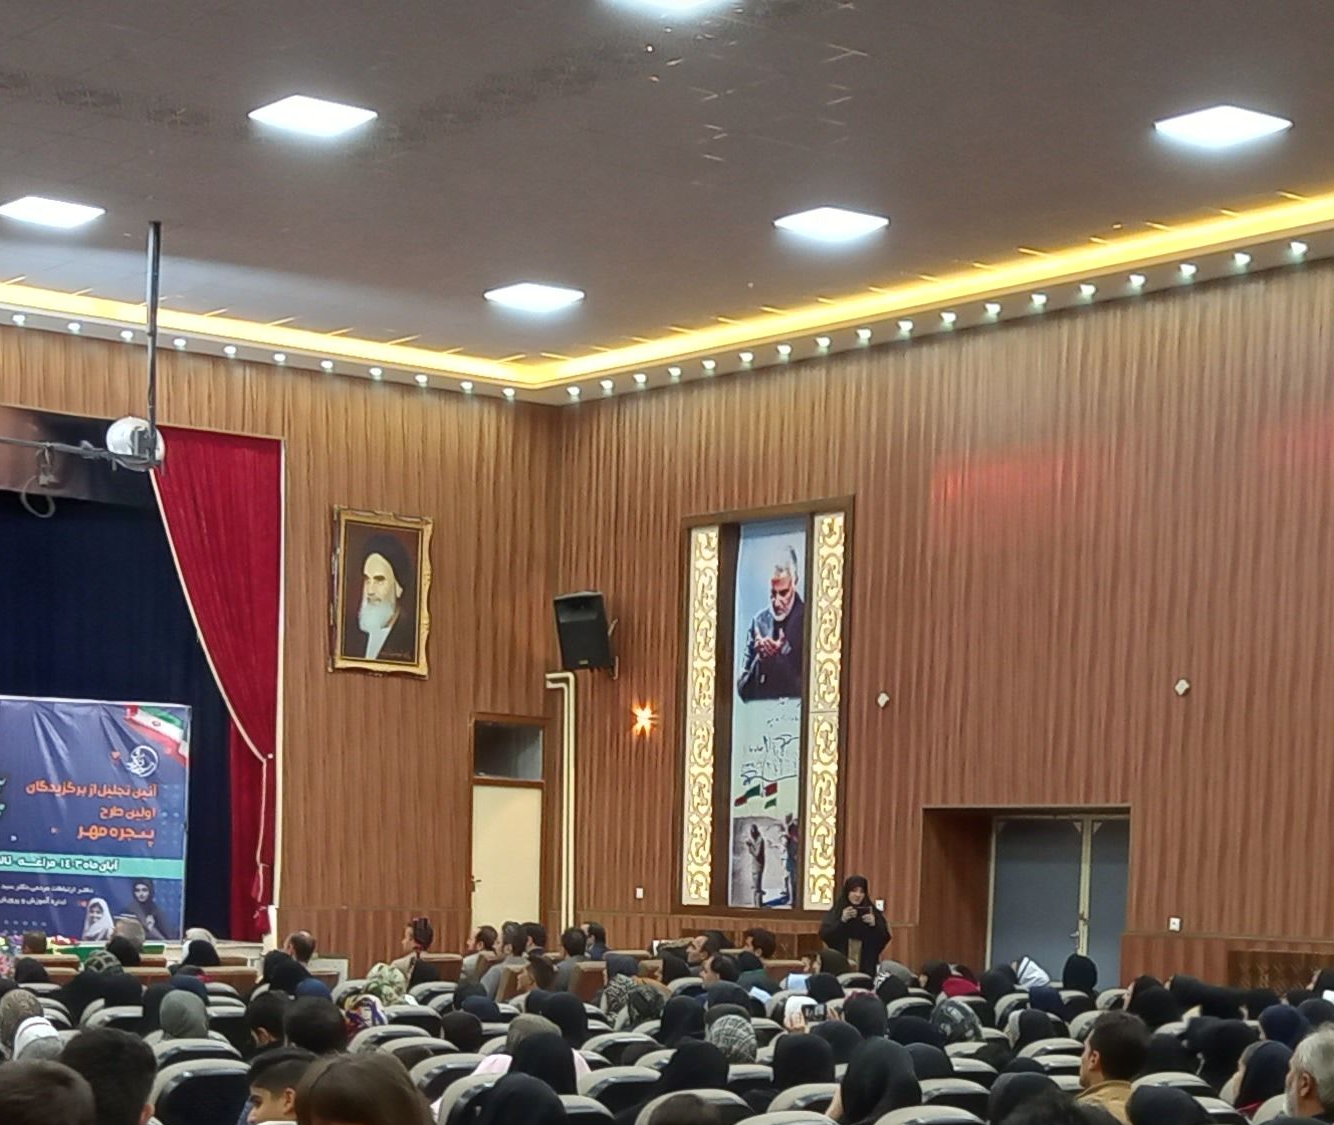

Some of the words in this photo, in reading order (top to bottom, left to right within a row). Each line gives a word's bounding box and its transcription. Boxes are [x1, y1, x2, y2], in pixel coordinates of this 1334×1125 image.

[25, 780, 87, 797] برگزیدگان
[88, 783, 97, 798] از
[99, 805, 124, 819] طرح
[125, 806, 156, 821] اولین
[77, 824, 107, 840] مهر
